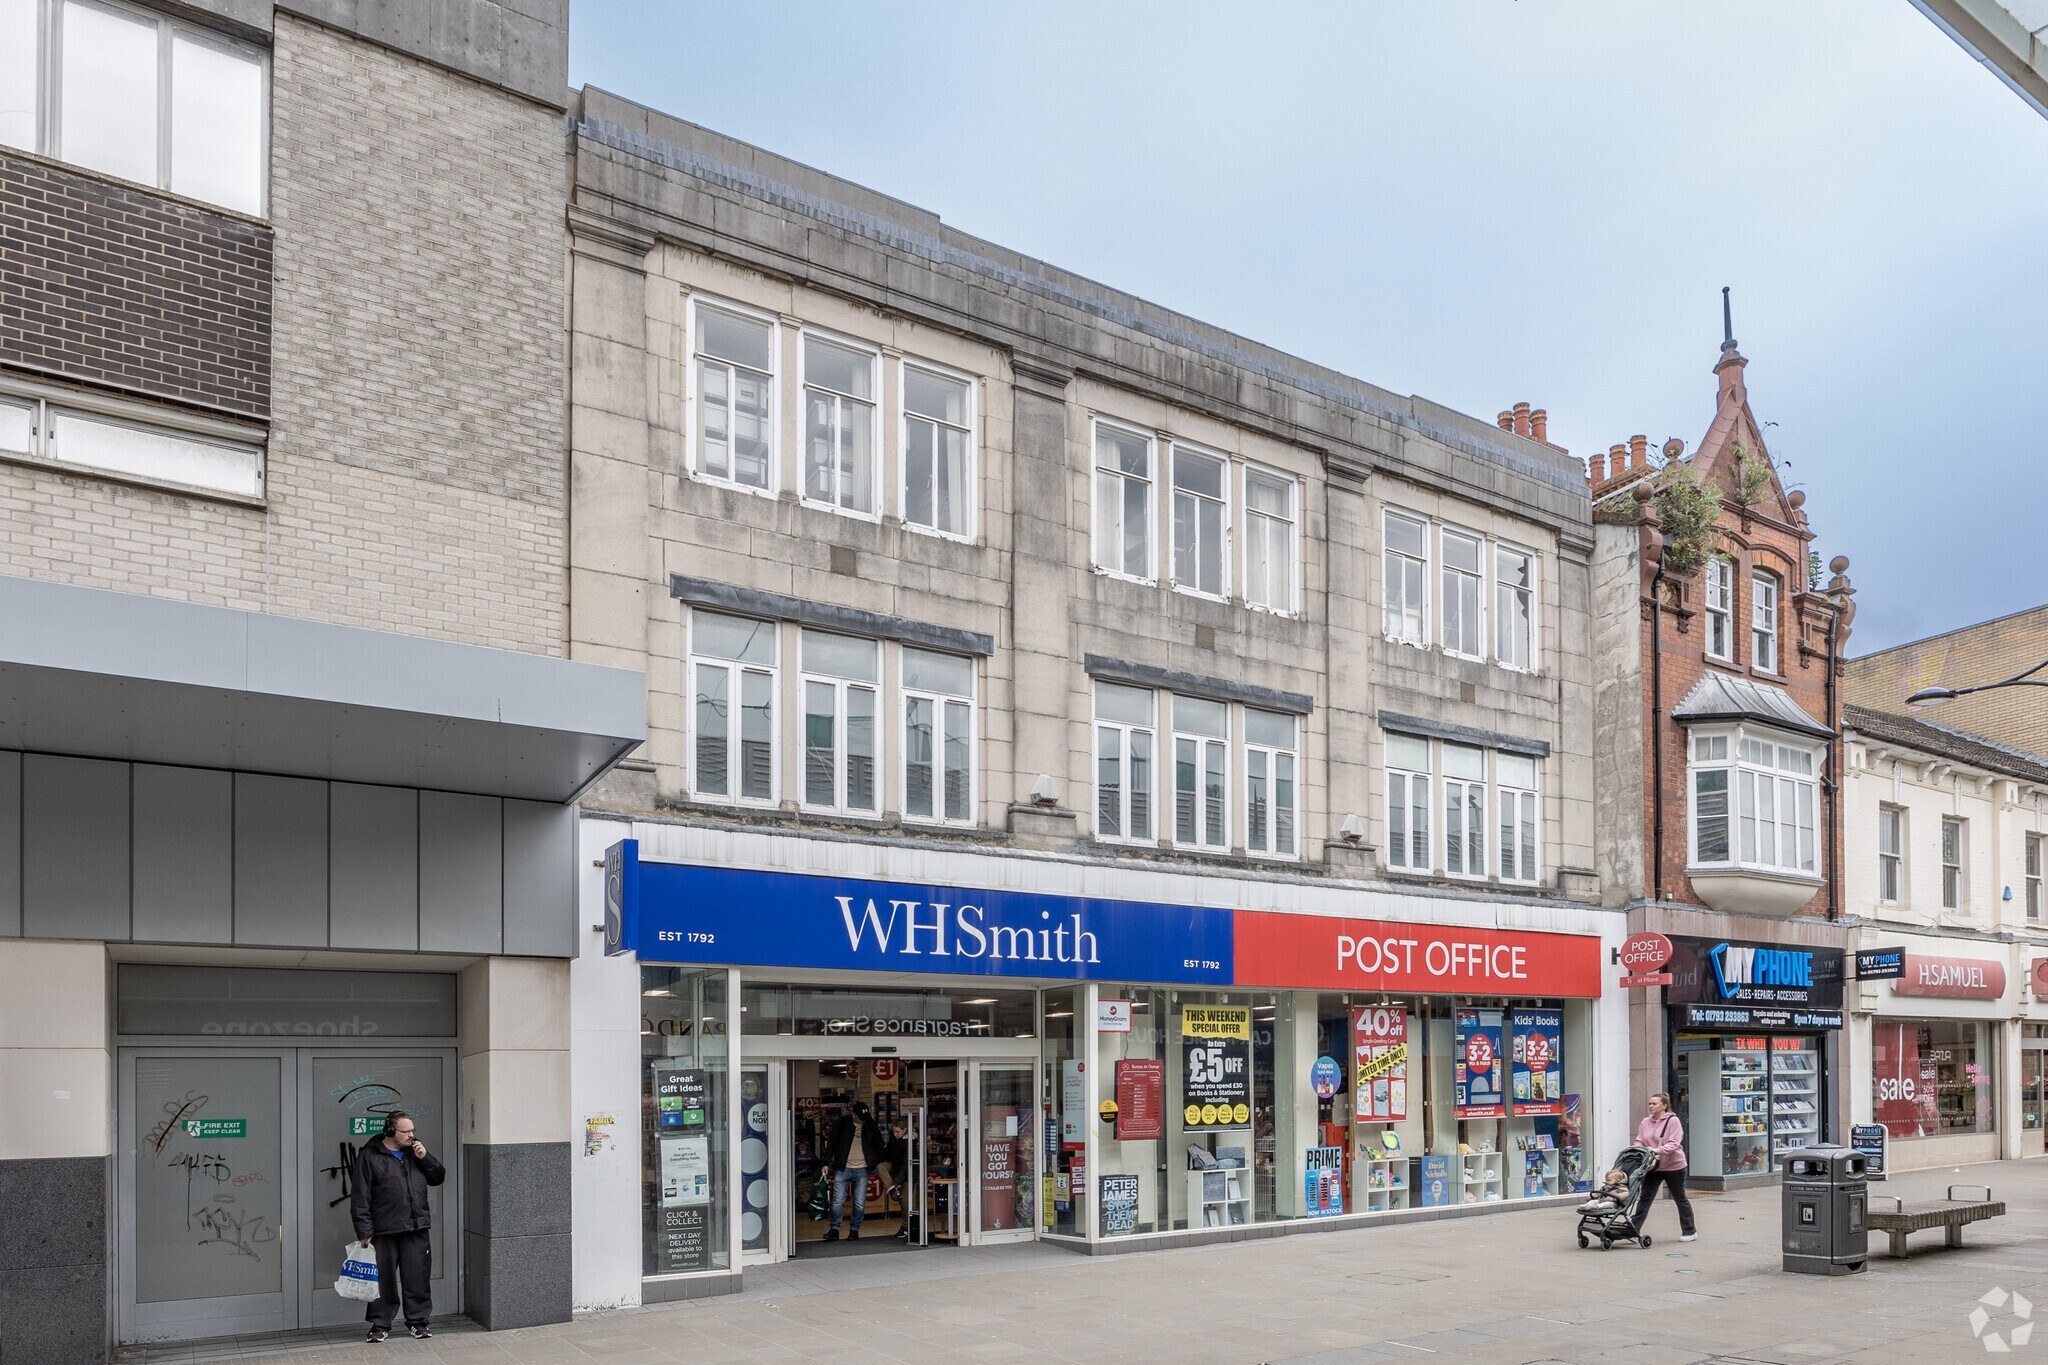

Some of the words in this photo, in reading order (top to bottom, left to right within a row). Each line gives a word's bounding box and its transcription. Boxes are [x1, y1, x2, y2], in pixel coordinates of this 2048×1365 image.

[834, 896, 1100, 963] WHSmith
[658, 931, 682, 942] EST
[687, 932, 715, 944] 1792
[1632, 940, 1660, 952] POST
[1337, 935, 1418, 974] POST
[1425, 940, 1527, 979] OFFICE
[1624, 951, 1664, 964] OFFICE
[1184, 959, 1199, 968] EST
[1201, 960, 1220, 970] 1792
[1776, 990, 1808, 1001] ACCESSORIES
[1186, 1010, 1205, 1022] THIS
[1207, 1010, 1246, 1022] WEEKEND
[1536, 1016, 1558, 1025] Books
[1691, 1010, 1704, 1021] Tel:
[1705, 1010, 1724, 1022] 01793
[1725, 1011, 1749, 1022] 293863
[1794, 1014, 1807, 1026] Open
[1808, 1015, 1812, 1024] 7
[1812, 1015, 1824, 1027] days
[1829, 1016, 1841, 1026] week
[1192, 1023, 1220, 1033] SPECIAL
[1221, 1024, 1240, 1033] OFFER
[1356, 1009, 1400, 1036] 40%
[1390, 1025, 1403, 1036] off
[1527, 1041, 1535, 1056] 3
[1540, 1041, 1548, 1056] 2
[1773, 1038, 1788, 1050] YOU
[1377, 1056, 1390, 1069] TIME
[1390, 1048, 1405, 1062] ONLY!
[1469, 1045, 1477, 1060] 3
[1482, 1045, 1490, 1060] 2
[876, 1059, 894, 1075] £1
[1190, 1048, 1224, 1083] £5
[1225, 1058, 1243, 1073] OFF
[1966, 1064, 1981, 1073] Hello
[1921, 1068, 1935, 1079] sale
[661, 1085, 677, 1093] Gift
[1880, 1078, 1915, 1101] sale
[986, 1144, 1010, 1152] HAVE
[988, 1153, 1007, 1161] YOU
[1307, 1149, 1340, 1170] PRIME
[988, 1162, 1007, 1170] GOT
[1429, 1161, 1444, 1170] David
[1104, 1179, 1137, 1190] PETER
[1102, 1189, 1137, 1201] JAMES
[1108, 1200, 1134, 1210] STOP
[1107, 1210, 1134, 1220] THEM
[666, 1217, 702, 1226] COLLECT
[1107, 1220, 1134, 1230] DEAD
